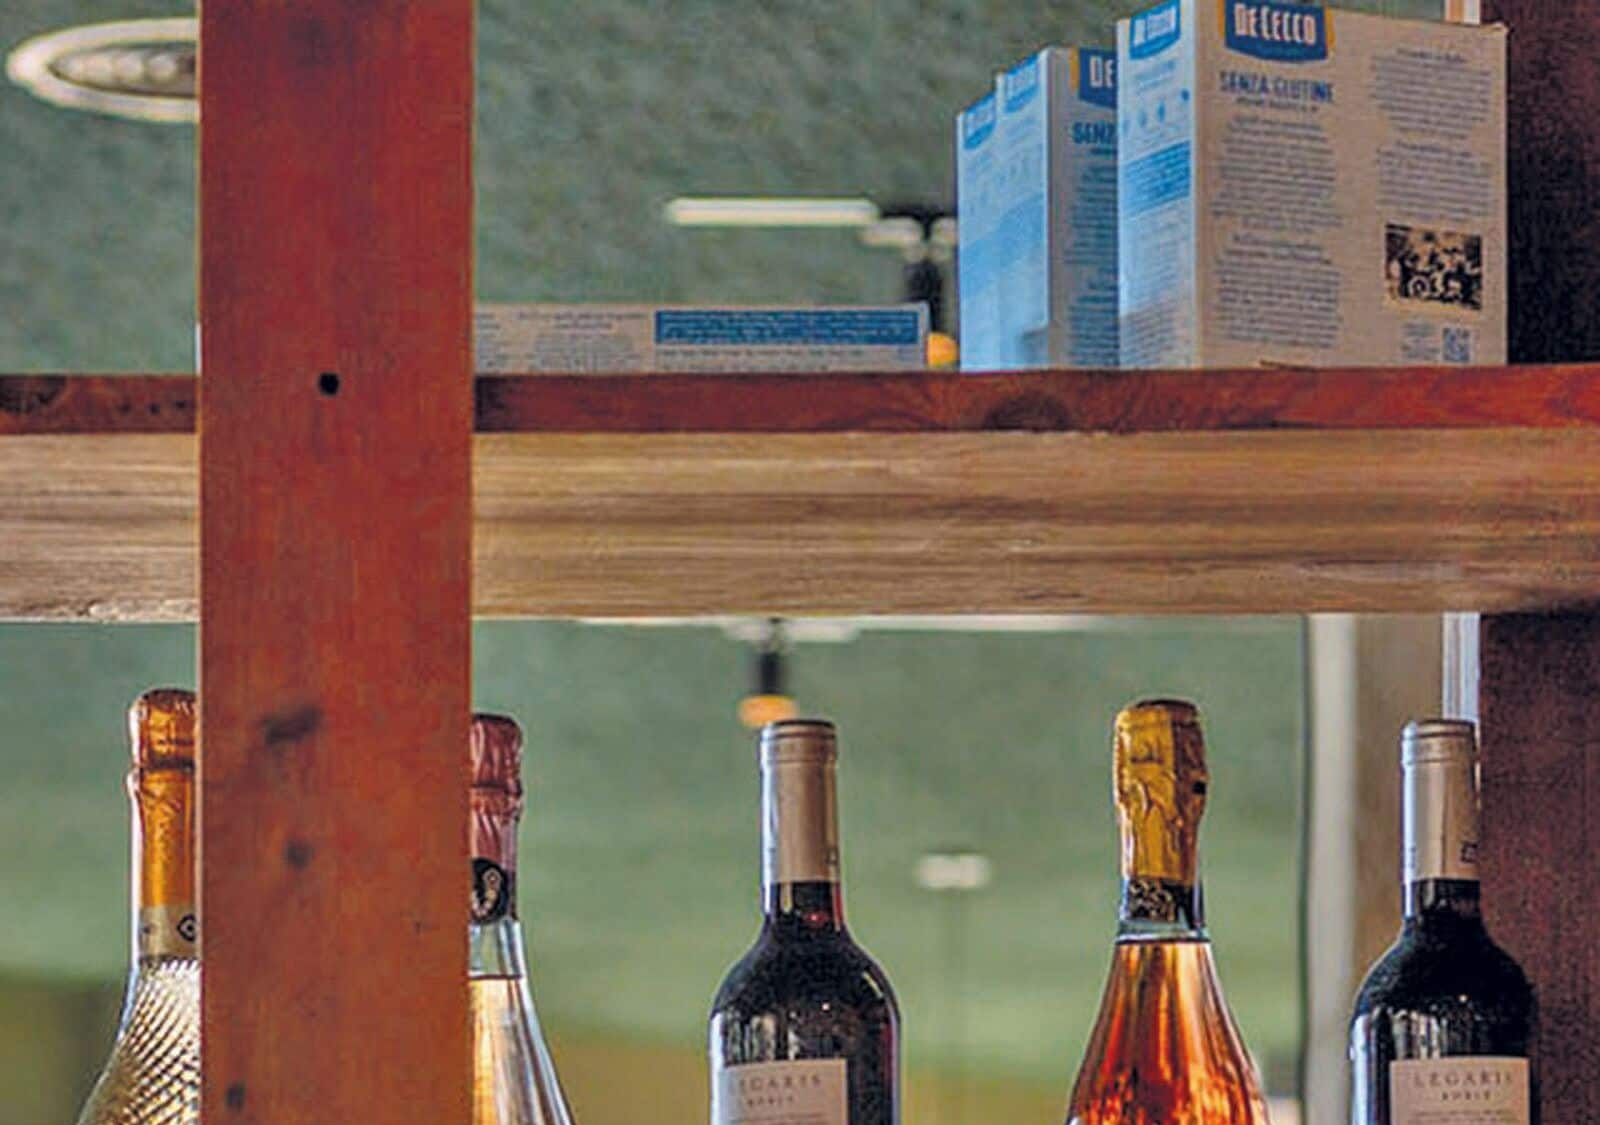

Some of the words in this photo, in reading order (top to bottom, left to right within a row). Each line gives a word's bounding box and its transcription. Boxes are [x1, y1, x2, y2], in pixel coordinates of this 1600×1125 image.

[1234, 3, 1257, 37] DE
[1259, 5, 1317, 46] CECCO
[1089, 55, 1116, 89] DE
[1073, 121, 1118, 145] SENZ
